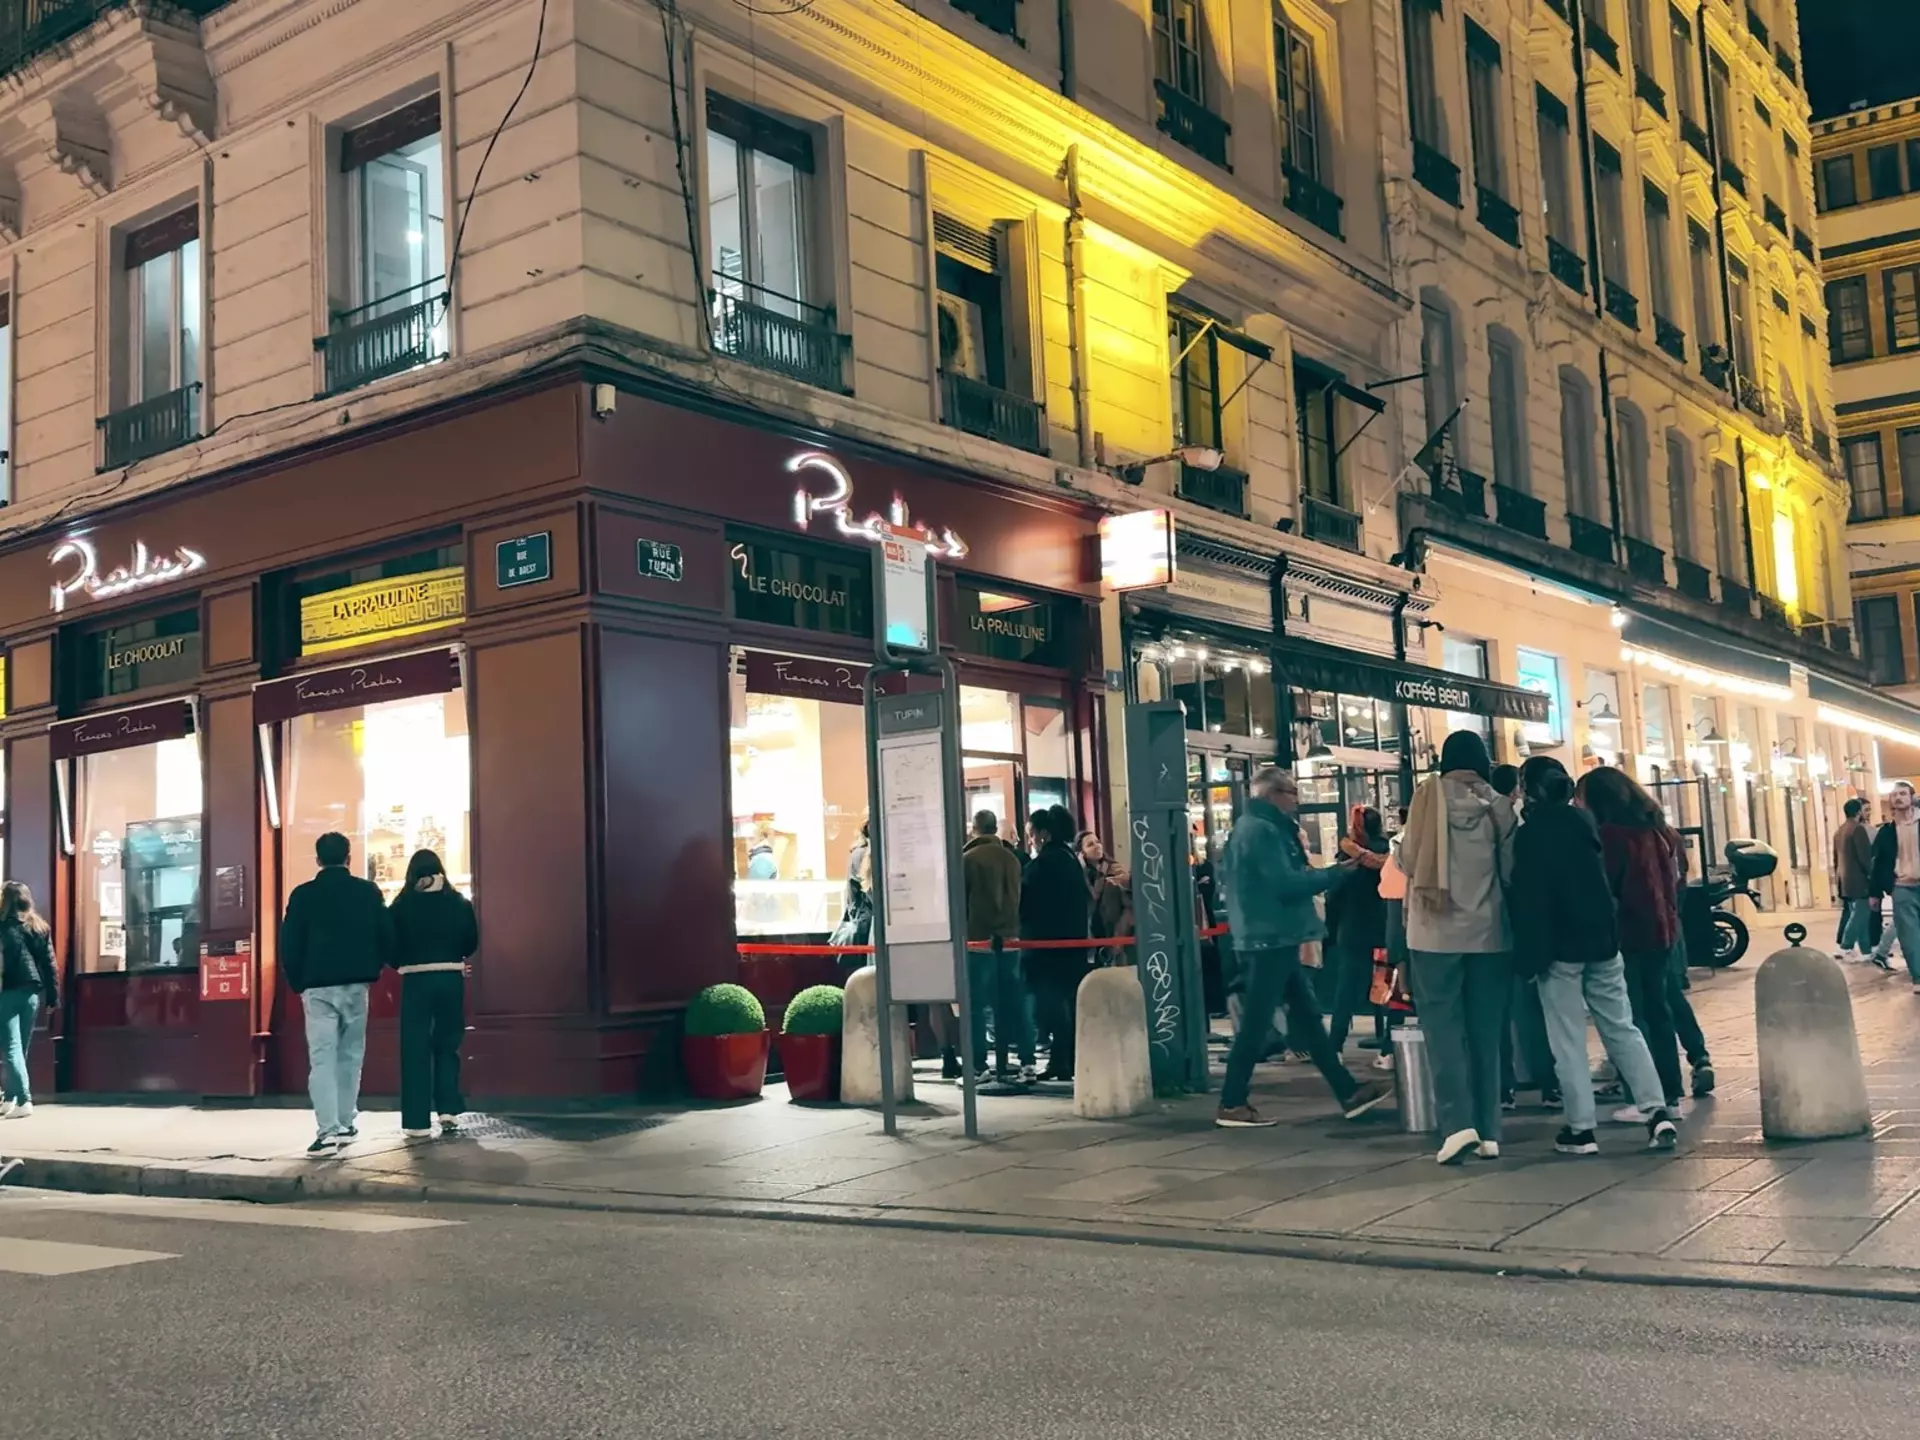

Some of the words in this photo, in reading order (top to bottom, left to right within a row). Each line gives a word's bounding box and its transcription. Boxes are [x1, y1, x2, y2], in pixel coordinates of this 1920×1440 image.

[652, 547, 671, 560] RUE
[48, 538, 206, 613] Pralus
[648, 559, 675, 574] TUPIN
[332, 601, 350, 620] LA
[351, 583, 430, 616] PRALULINE
[748, 575, 767, 593] LE
[771, 579, 847, 606] CHOCOLAT
[970, 615, 985, 632] LA
[987, 617, 1045, 642] PRALULINE
[108, 653, 121, 669] LE
[124, 638, 183, 666] CHOCOLAT
[351, 668, 403, 690] Pralus
[117, 716, 157, 737] Pralus
[895, 708, 924, 721] TUPIN
